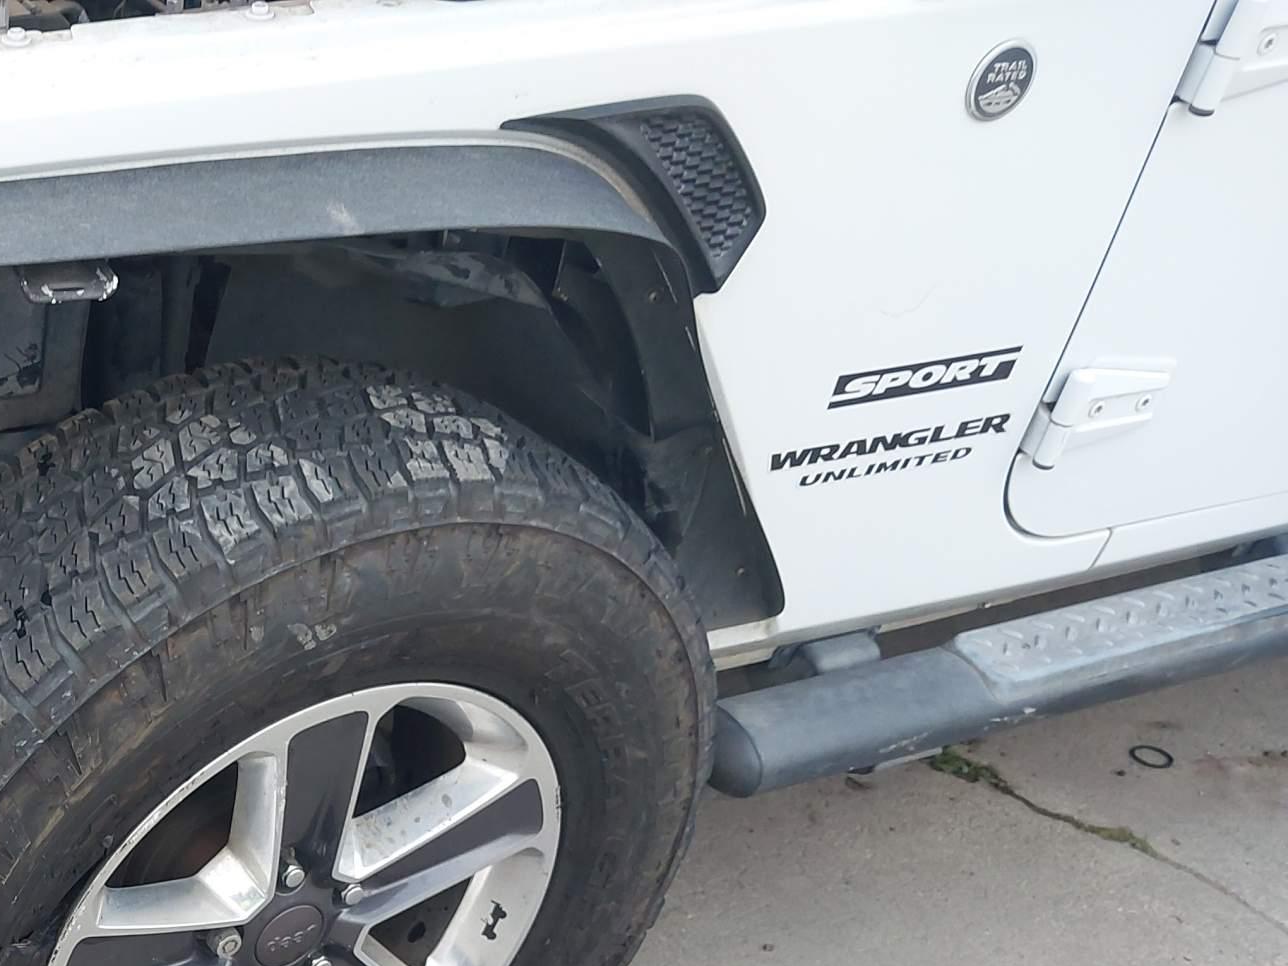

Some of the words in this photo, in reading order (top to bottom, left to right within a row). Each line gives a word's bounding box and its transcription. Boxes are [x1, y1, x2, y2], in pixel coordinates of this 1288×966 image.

[986, 70, 1027, 84] RATED
[993, 60, 1028, 73] TRAIL
[831, 351, 1020, 400] SPORT
[769, 413, 1011, 471] WRANGLER
[798, 446, 973, 487] UNLIMITED
